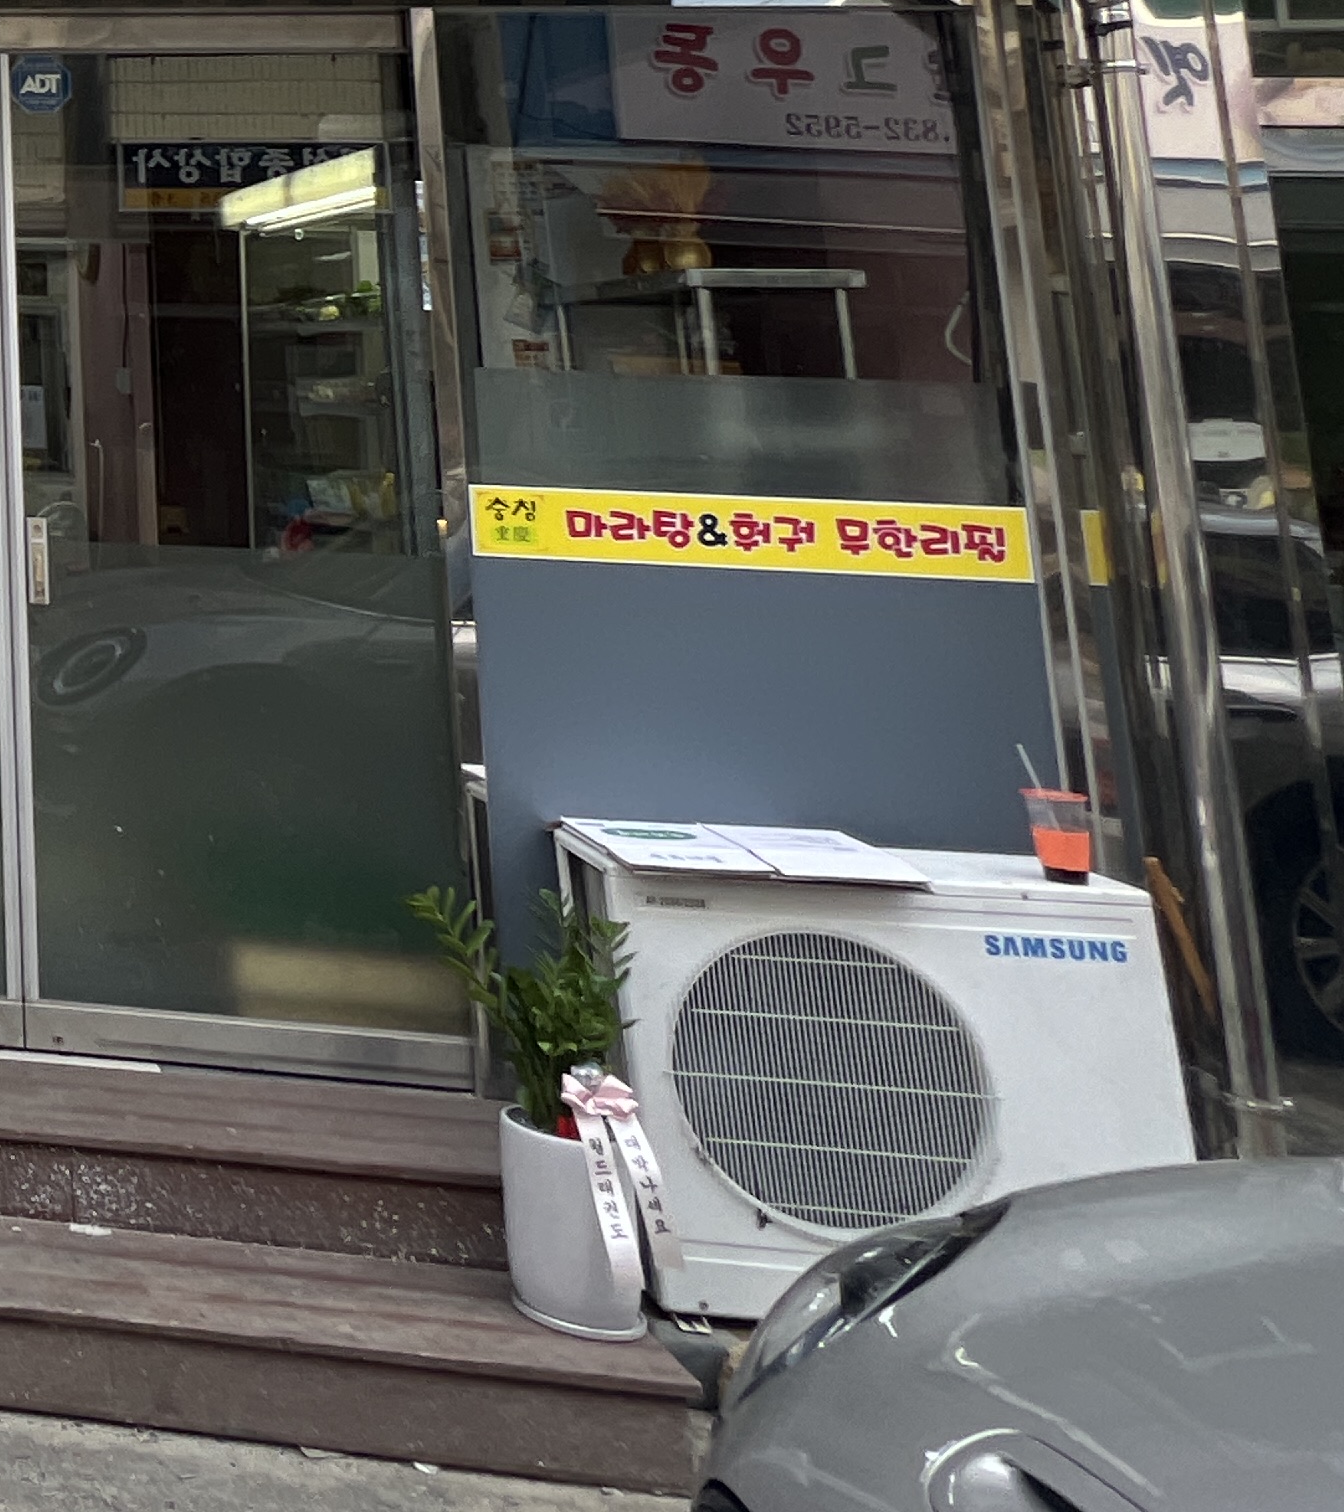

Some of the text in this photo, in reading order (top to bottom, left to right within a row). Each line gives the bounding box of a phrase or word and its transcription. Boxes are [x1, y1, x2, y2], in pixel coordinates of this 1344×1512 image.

[19, 73, 62, 94] ADT
[835, 517, 1008, 567] 무한리필
[984, 932, 1129, 963] SAMSUNG
